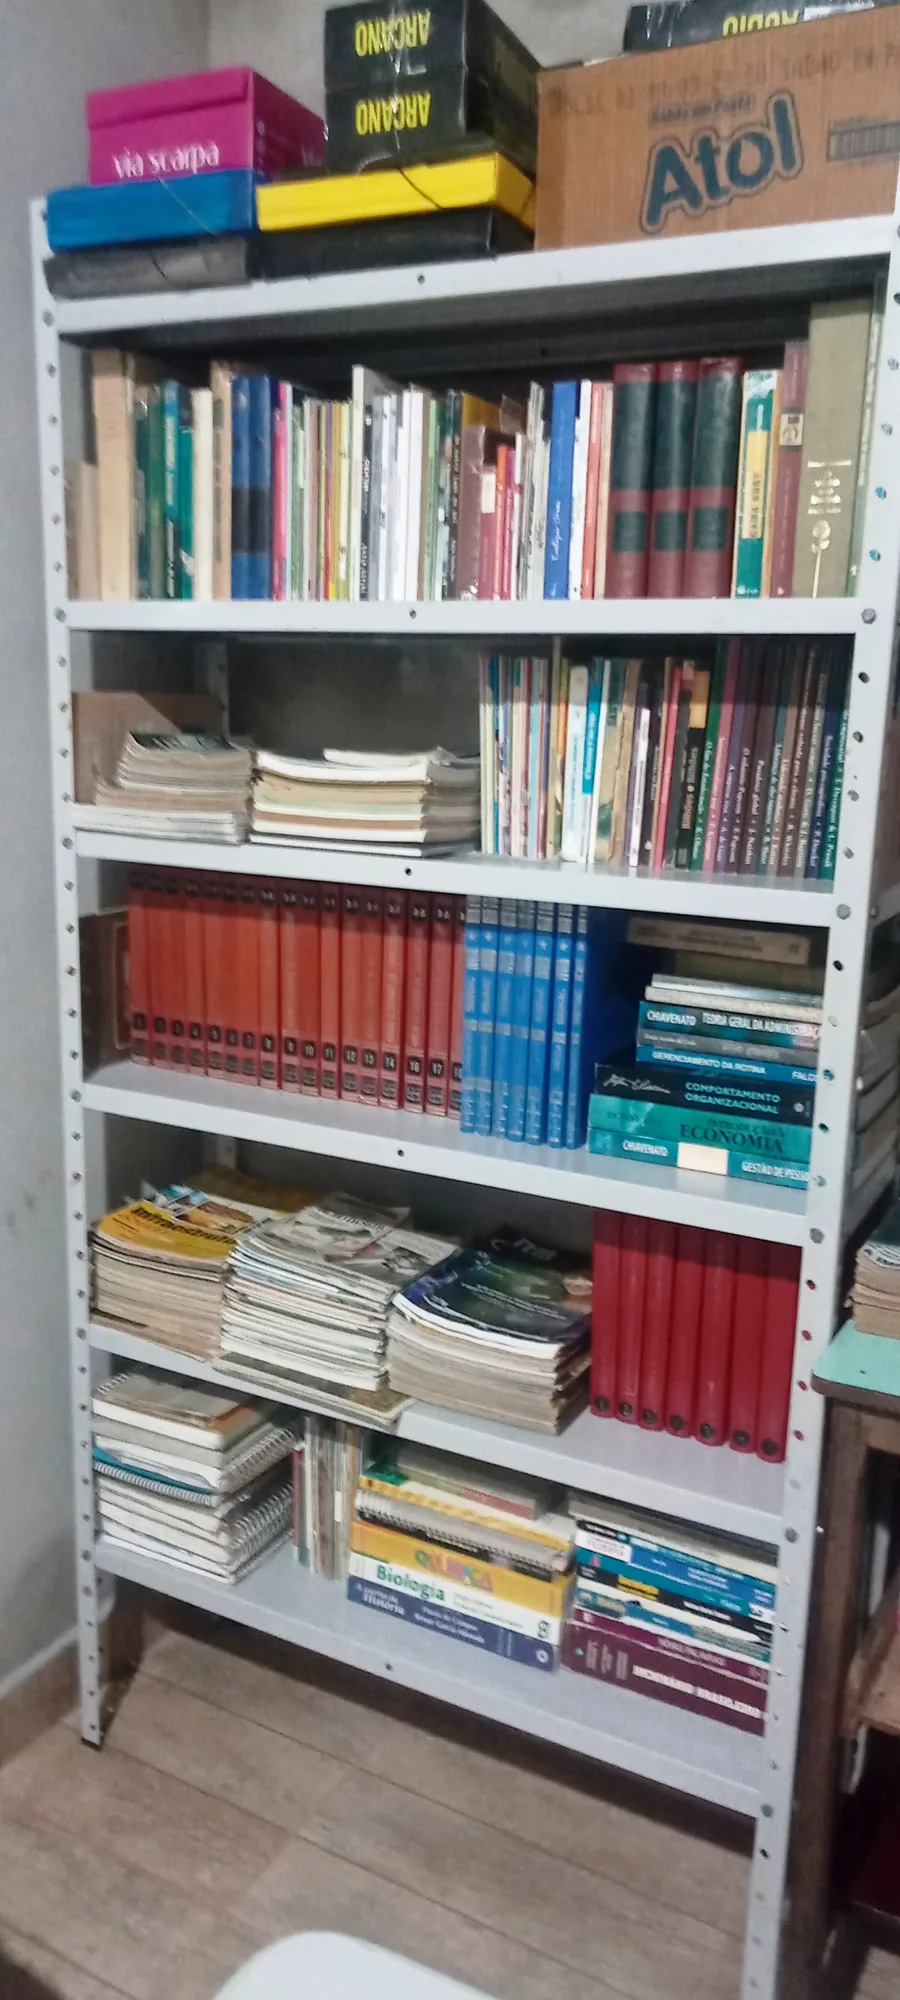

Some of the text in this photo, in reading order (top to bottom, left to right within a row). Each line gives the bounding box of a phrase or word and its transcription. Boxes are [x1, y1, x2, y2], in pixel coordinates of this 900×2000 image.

[355, 10, 431, 57] ARCANO
[355, 91, 431, 136] ARCANO
[113, 142, 219, 179] via scarpa
[643, 93, 800, 231] Atol
[646, 1009, 697, 1027] CHIAVENATO
[702, 1011, 728, 1026] TEORIA
[728, 1014, 751, 1029] GERAL
[752, 1018, 763, 1031] DA
[651, 1050, 721, 1069] GERENCIAMENTO
[722, 1060, 734, 1070] DA
[684, 1092, 779, 1115] ORGANIZACIONAL
[685, 1081, 781, 1103] COMPORTAMENTO
[679, 1123, 784, 1153] ECONOMIA
[376, 1565, 446, 1601] Biologia
